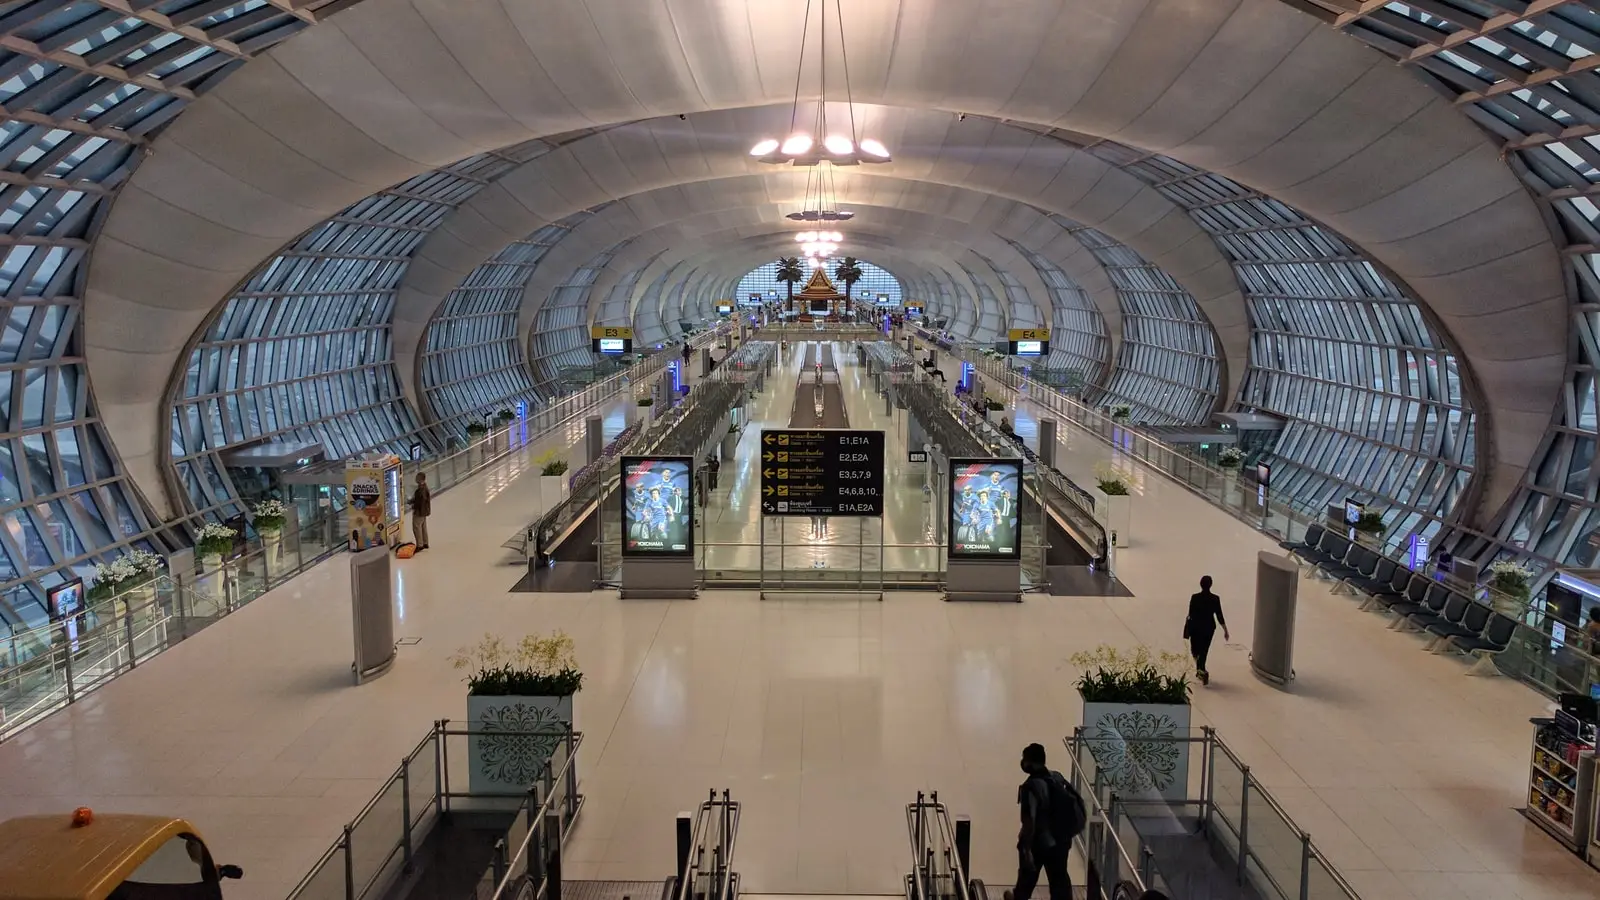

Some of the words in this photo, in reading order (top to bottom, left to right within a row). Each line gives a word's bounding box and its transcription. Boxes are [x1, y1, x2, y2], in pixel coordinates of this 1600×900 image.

[605, 328, 618, 336] E3
[1022, 331, 1035, 339] E4
[839, 436, 870, 446] E1,E1A
[839, 453, 869, 462] E2,E2A
[839, 471, 871, 479] E3,5,7,9
[839, 503, 874, 512] E1A,E2A
